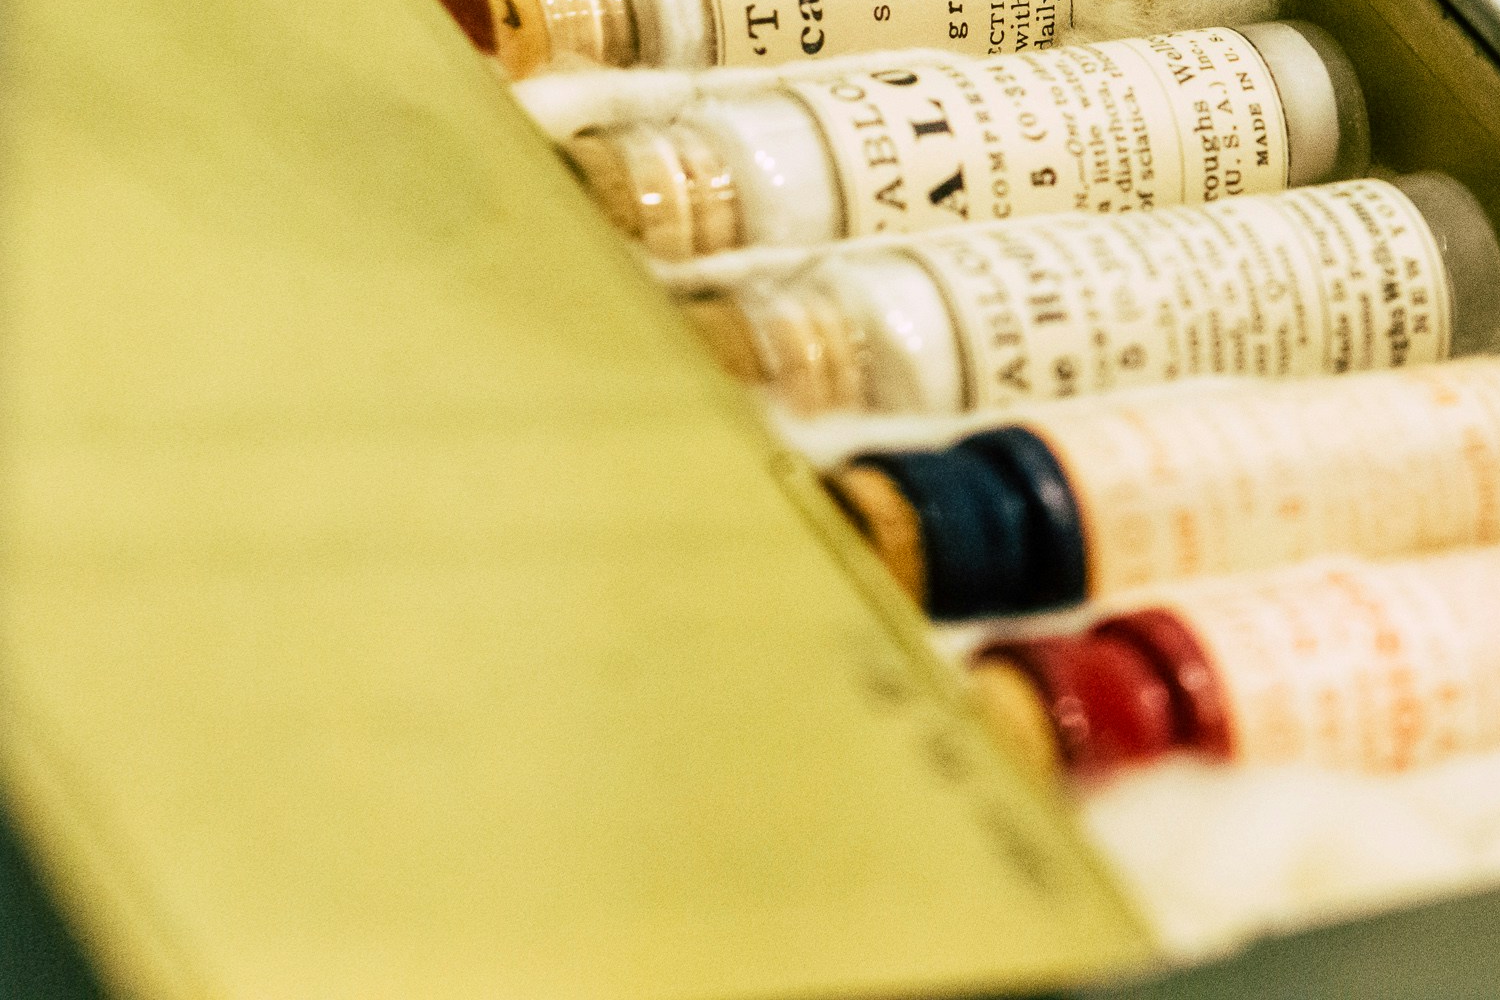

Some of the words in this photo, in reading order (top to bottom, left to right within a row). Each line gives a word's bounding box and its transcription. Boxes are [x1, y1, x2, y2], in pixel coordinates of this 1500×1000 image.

[1233, 71, 1256, 93] IN
[1248, 102, 1270, 168] MADE
[1029, 166, 1059, 188] 5
